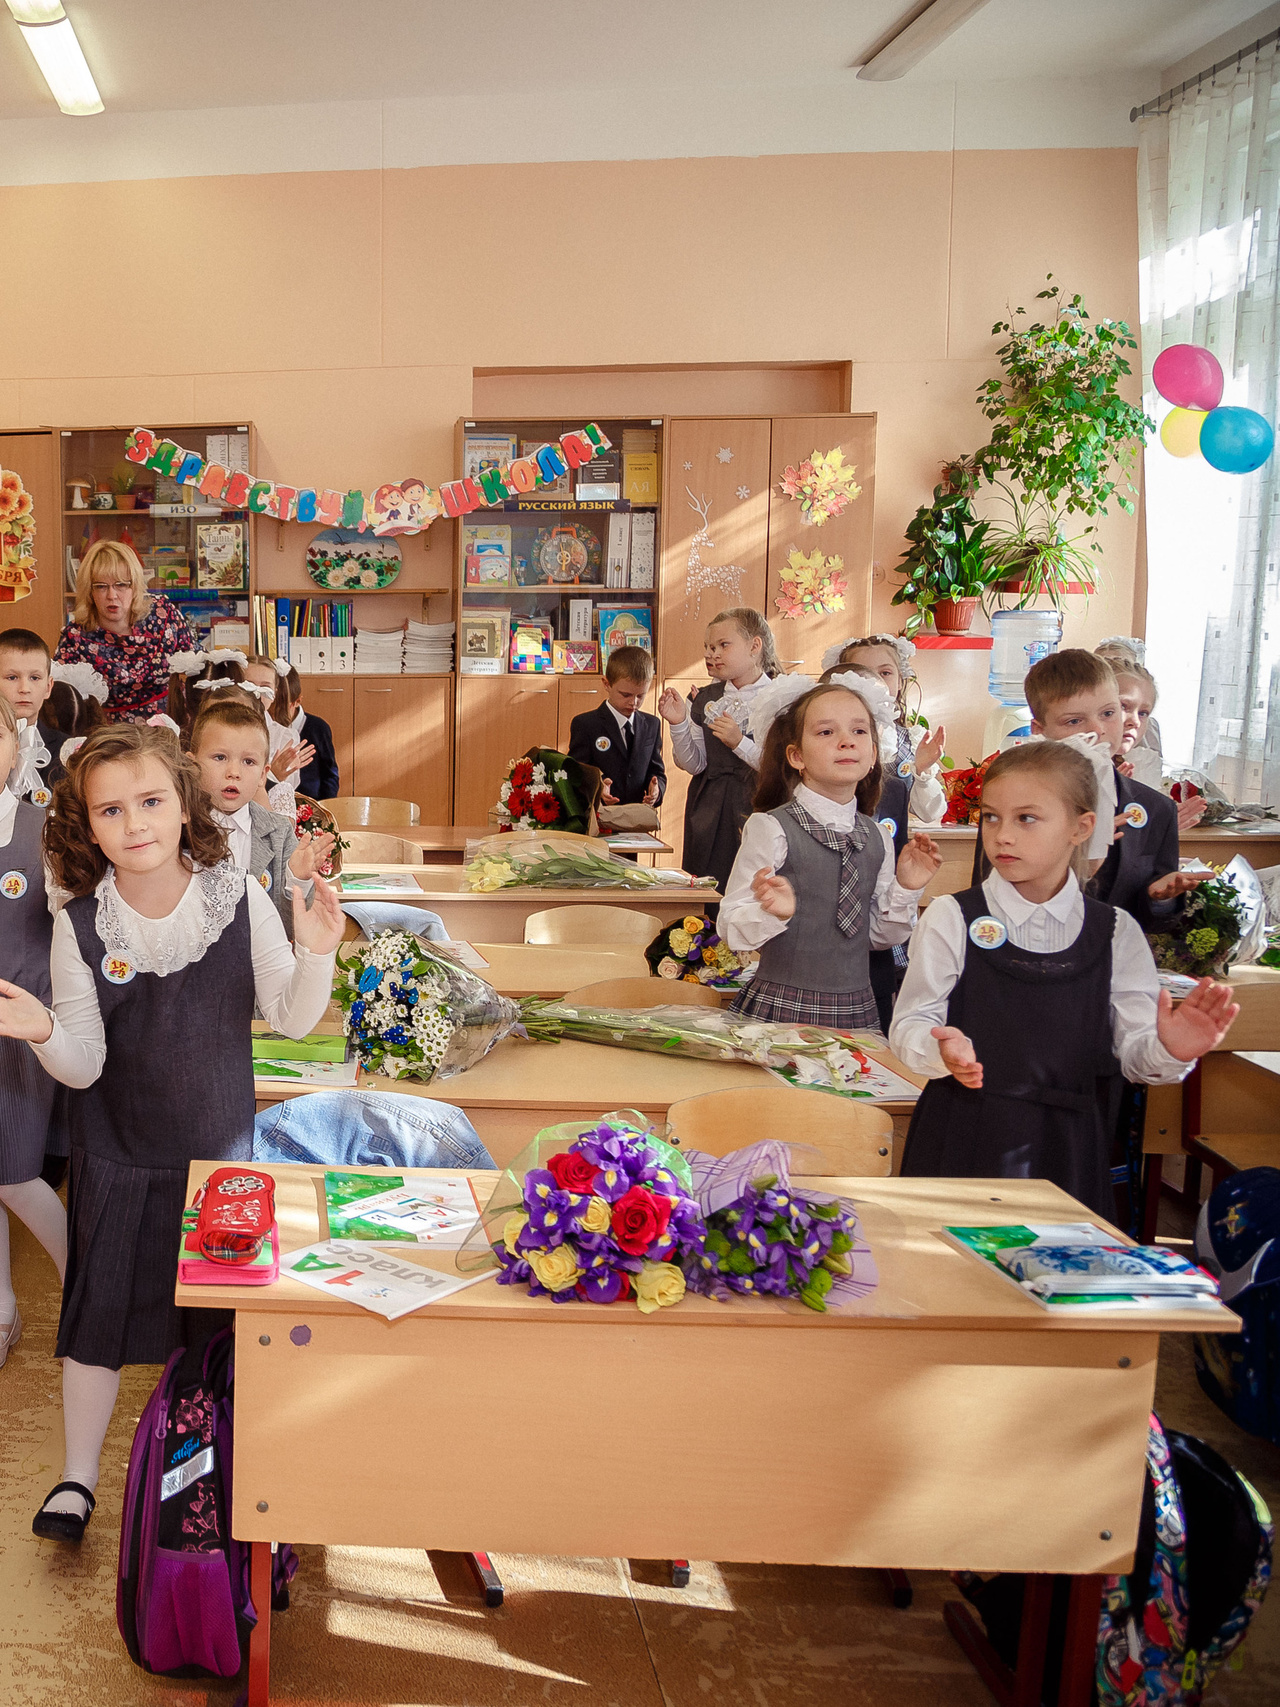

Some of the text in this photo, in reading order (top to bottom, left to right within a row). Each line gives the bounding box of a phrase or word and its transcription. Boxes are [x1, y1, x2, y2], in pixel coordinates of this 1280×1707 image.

[240, 442, 248, 474] АЛЬБО
[439, 423, 606, 518] ШКОЛА!
[170, 505, 197, 514] ИЗО
[518, 500, 615, 510] РУССКИЙ ЯЗЫК
[298, 653, 302, 664] 1
[319, 660, 326, 671] 2
[339, 659, 346, 671] 3
[7, 879, 20, 888] 1А
[980, 925, 996, 934] 1А
[289, 1252, 365, 1287] 1 А
[325, 1244, 447, 1289] класс
